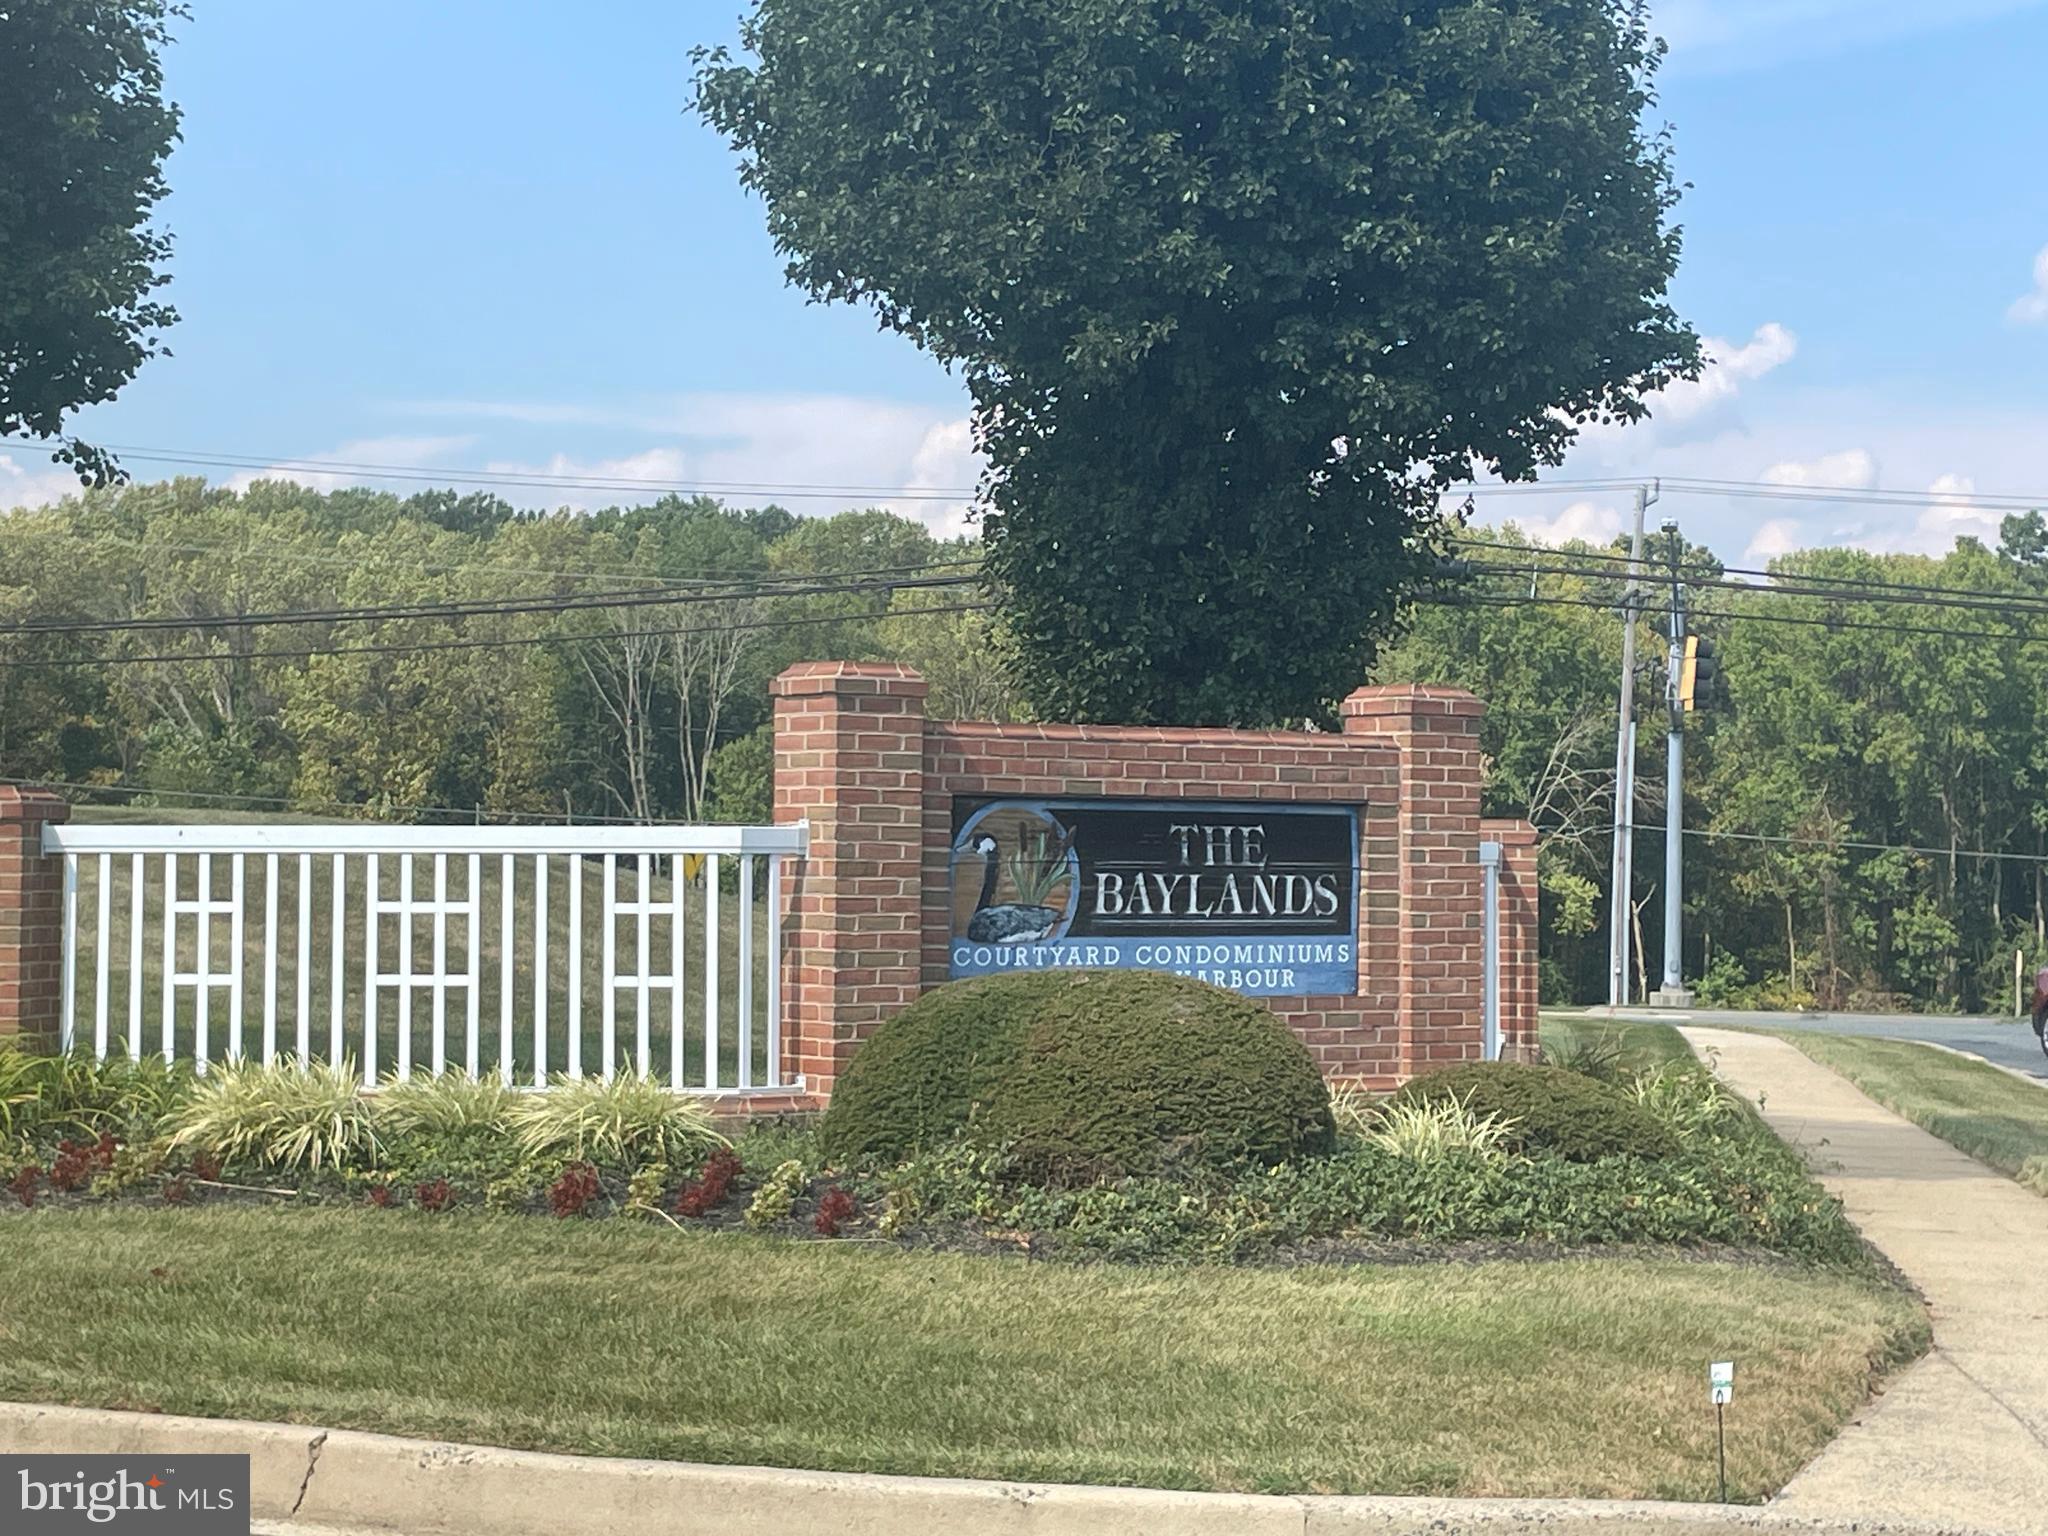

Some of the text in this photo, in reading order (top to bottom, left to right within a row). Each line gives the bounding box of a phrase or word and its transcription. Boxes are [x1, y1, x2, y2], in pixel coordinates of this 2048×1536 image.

[1169, 823, 1268, 870] THE
[1095, 872, 1339, 918] BAYLANDS
[953, 943, 1351, 967] COURTYARD CONDOMINIUMS
[1175, 968, 1296, 988] ARBOUR
